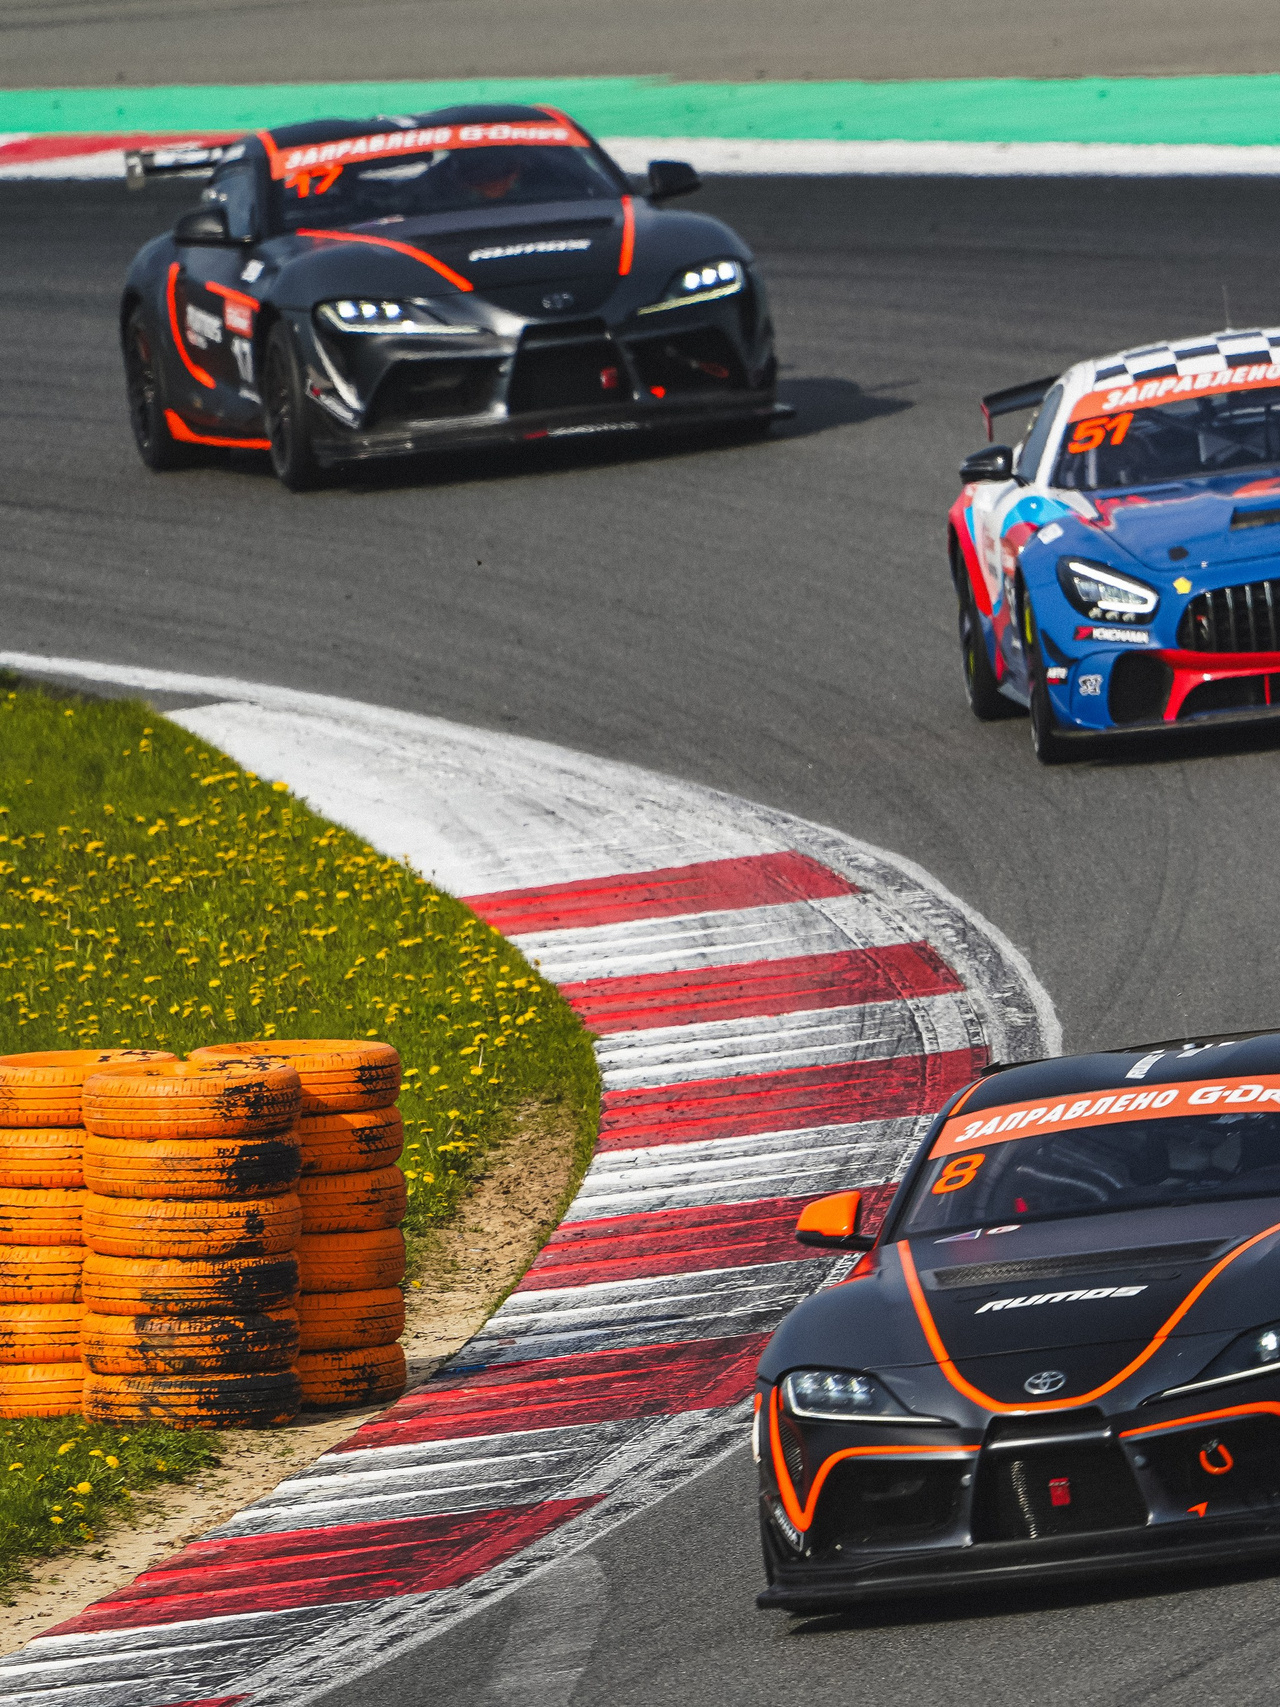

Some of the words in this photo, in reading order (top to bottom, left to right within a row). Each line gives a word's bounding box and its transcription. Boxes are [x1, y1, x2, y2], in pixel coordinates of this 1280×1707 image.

[284, 163, 344, 198] 17
[1067, 411, 1135, 454] 51
[953, 1089, 1180, 1143] ЗАПРАВЛЕНО
[931, 1153, 985, 1195] 8
[974, 1285, 1149, 1315] RUMOS
